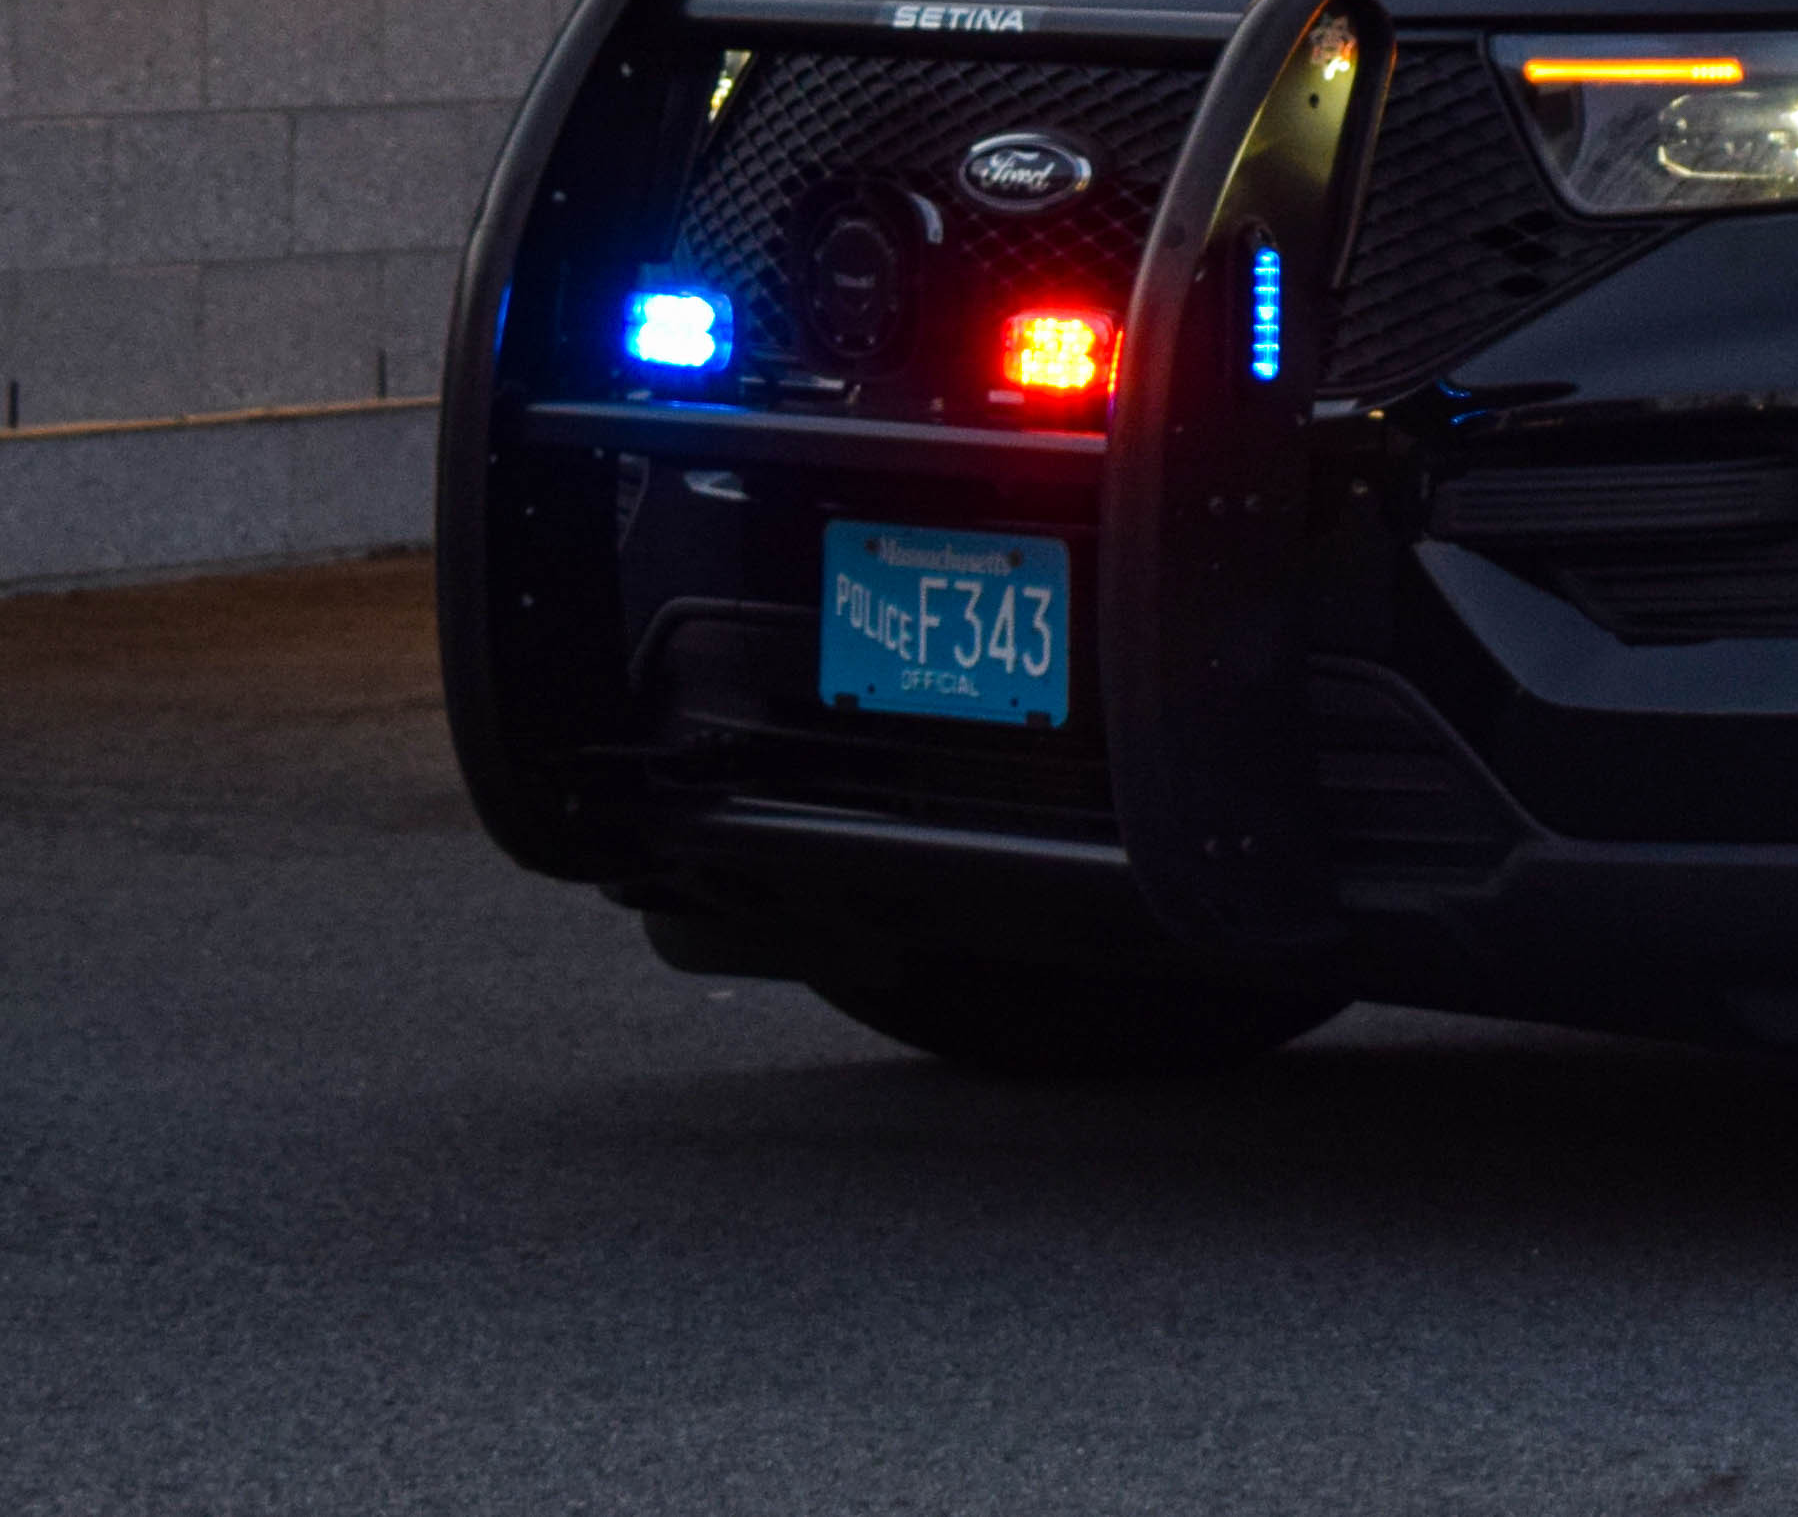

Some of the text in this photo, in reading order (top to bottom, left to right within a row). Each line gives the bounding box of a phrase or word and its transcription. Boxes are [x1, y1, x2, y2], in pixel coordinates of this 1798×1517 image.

[893, 5, 1024, 32] SETINA
[978, 150, 1056, 192] Ford
[879, 536, 1012, 576] Massachusetts
[835, 572, 1053, 676] POLICE F343
[901, 669, 980, 697] OFFICIAL
